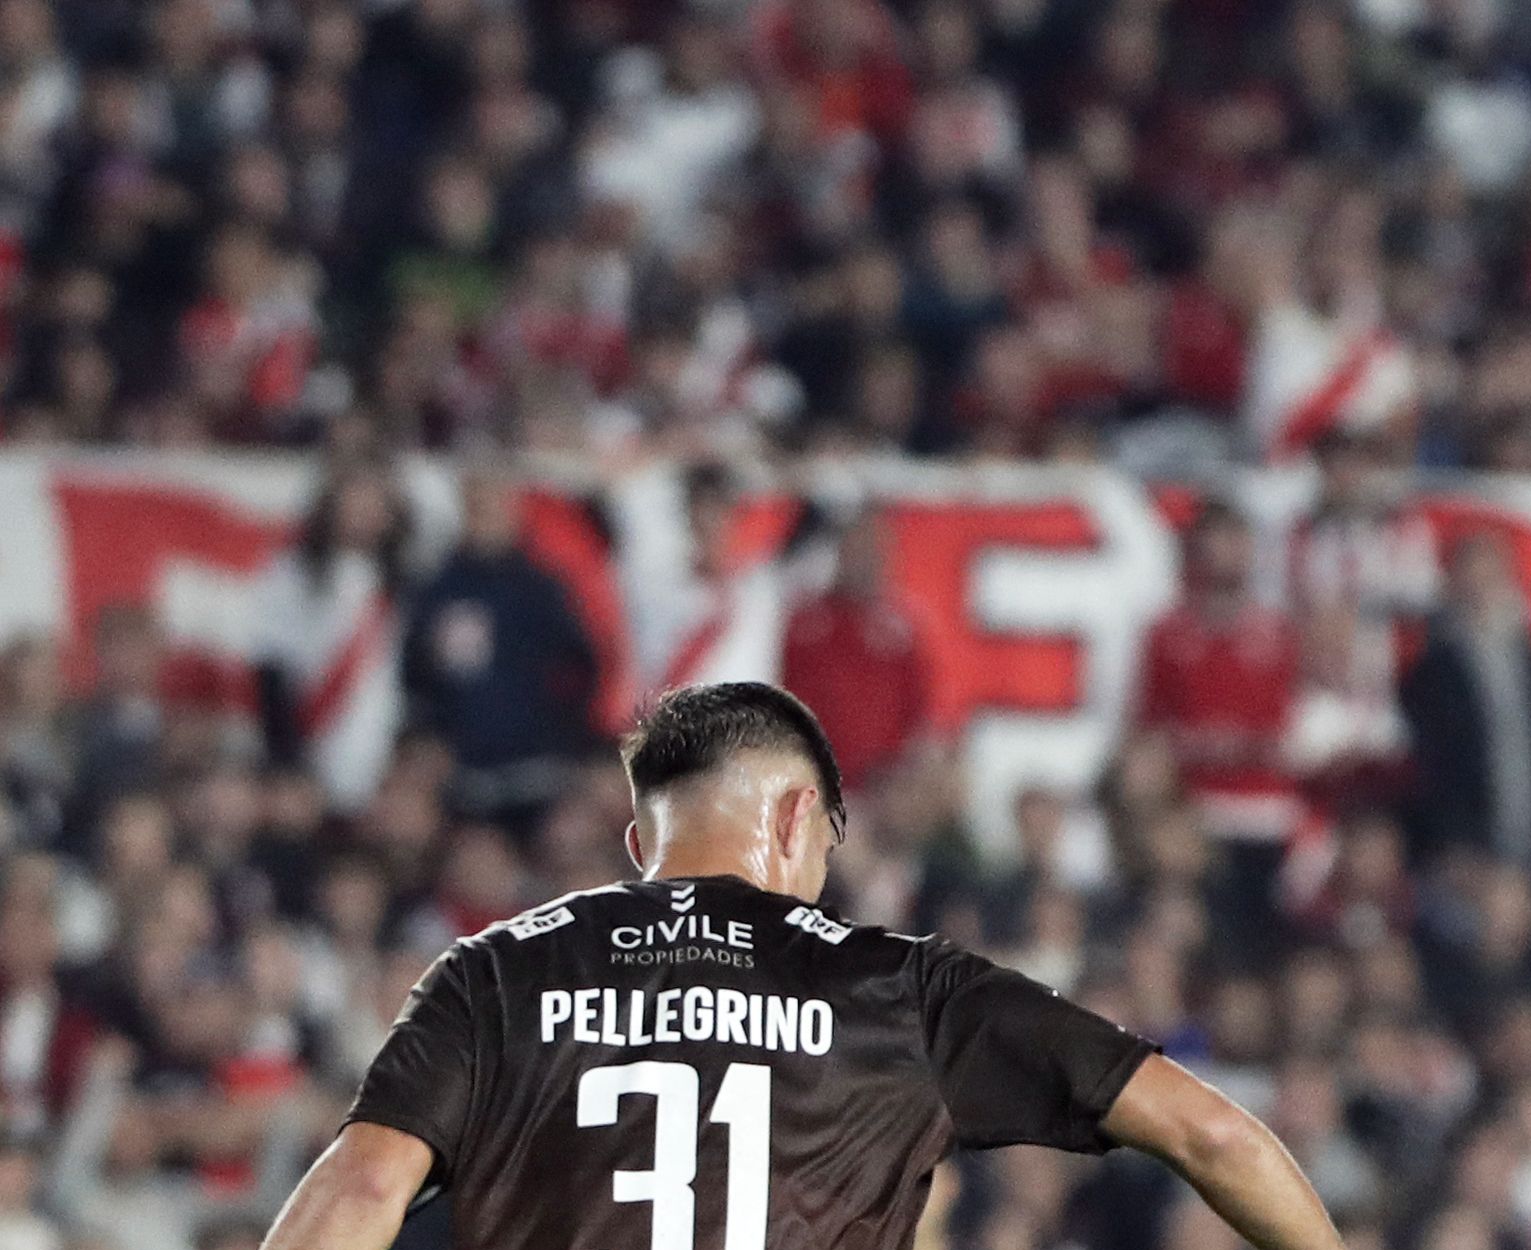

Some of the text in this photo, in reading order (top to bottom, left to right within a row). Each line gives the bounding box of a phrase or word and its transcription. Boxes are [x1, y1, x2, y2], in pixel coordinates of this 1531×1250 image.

[611, 914, 754, 950] CIVILE
[610, 946, 755, 970] PROPIEDADES
[540, 986, 834, 1057] PELLEGRINO
